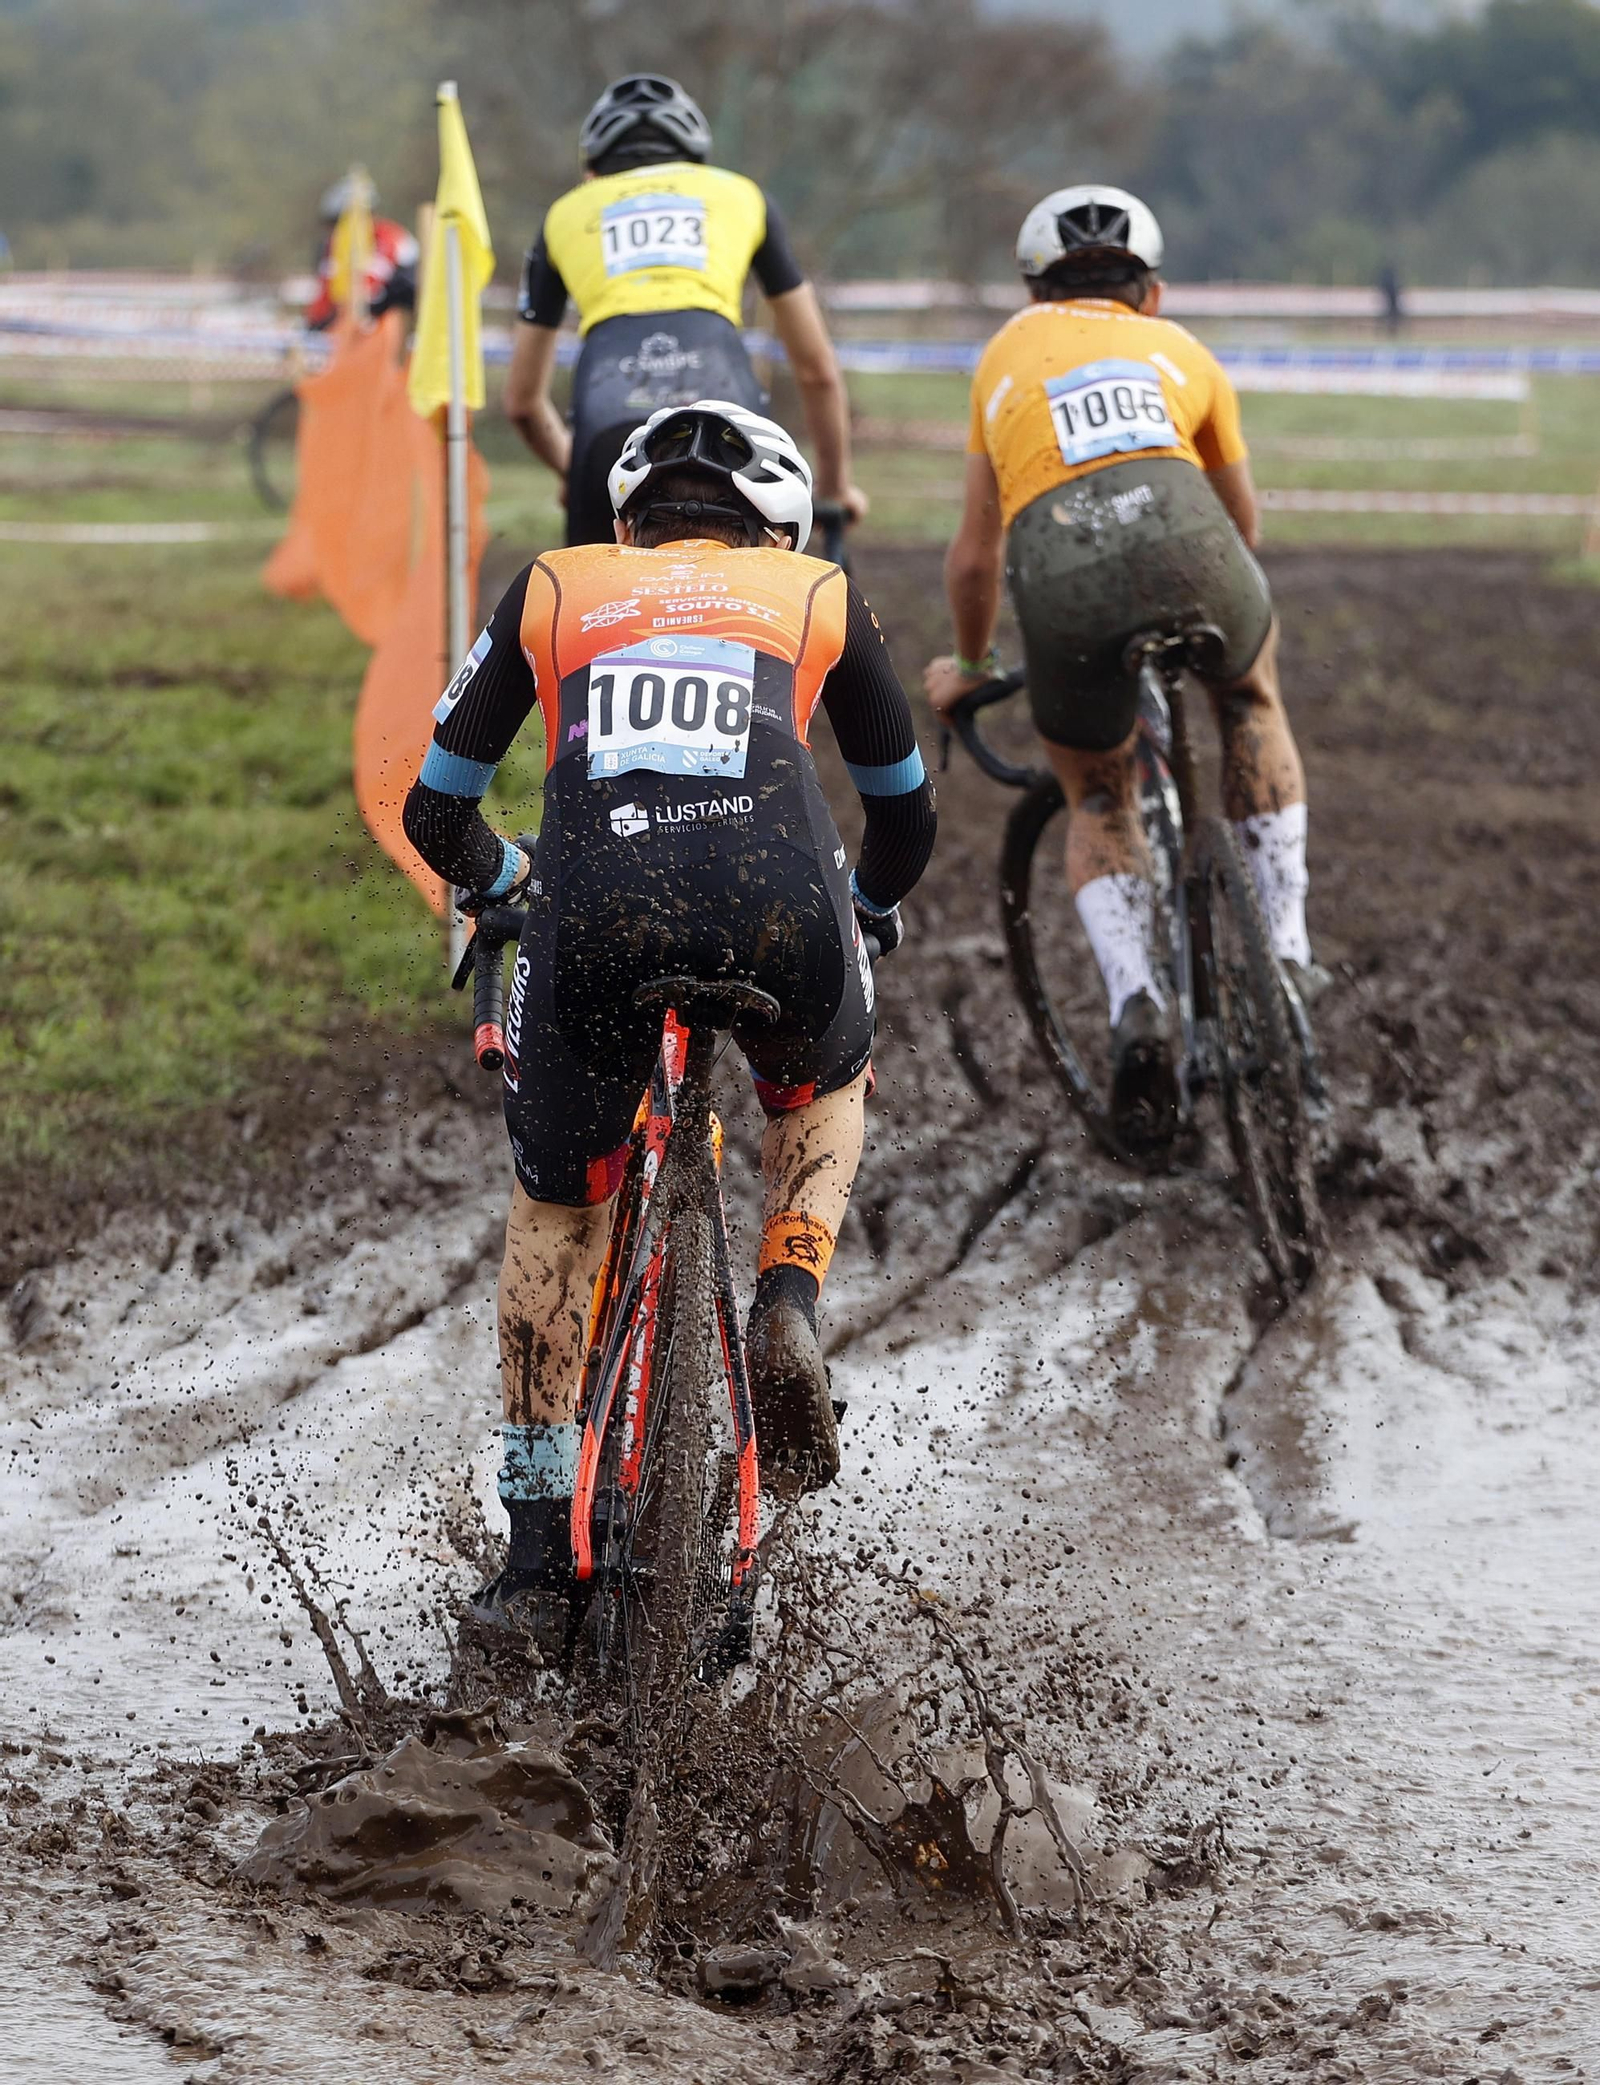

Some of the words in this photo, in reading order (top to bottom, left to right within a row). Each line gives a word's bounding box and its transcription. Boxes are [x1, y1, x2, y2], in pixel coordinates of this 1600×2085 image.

[603, 215, 703, 254] 1023
[631, 583, 729, 597] SESTELO
[659, 596, 717, 605] SERVICIOS
[665, 601, 740, 613] SOUTO
[591, 672, 751, 737] 1008
[620, 746, 648, 759] XUNTA
[620, 757, 627, 767] DE
[631, 750, 667, 763] GALICIA
[655, 796, 754, 823] LUSTAND
[658, 822, 708, 835] SERVICIOS
